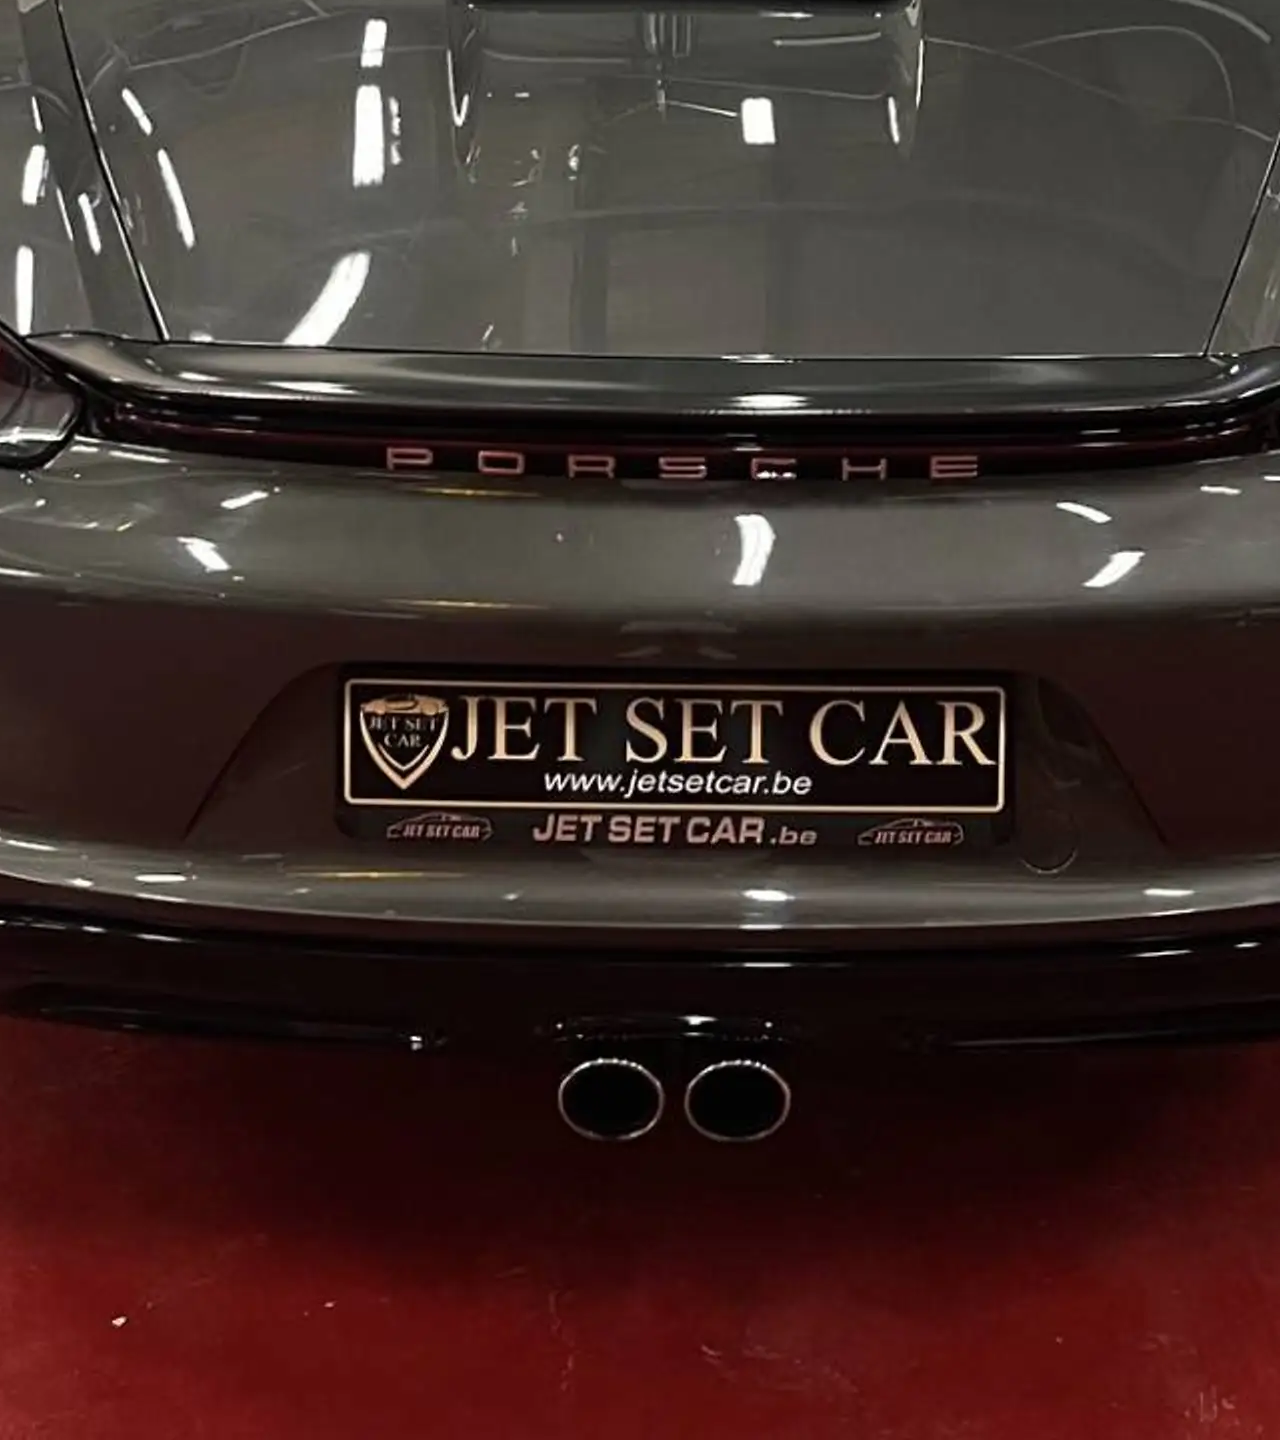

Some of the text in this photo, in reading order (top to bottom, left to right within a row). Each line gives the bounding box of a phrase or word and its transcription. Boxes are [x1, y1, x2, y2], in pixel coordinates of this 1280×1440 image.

[386, 447, 979, 480] PORSCHE
[383, 733, 423, 748] CAR
[451, 695, 998, 767] JET SET CAR
[544, 769, 813, 799] www.jetsetcar.be
[533, 813, 603, 842] JET
[608, 814, 681, 844] SET
